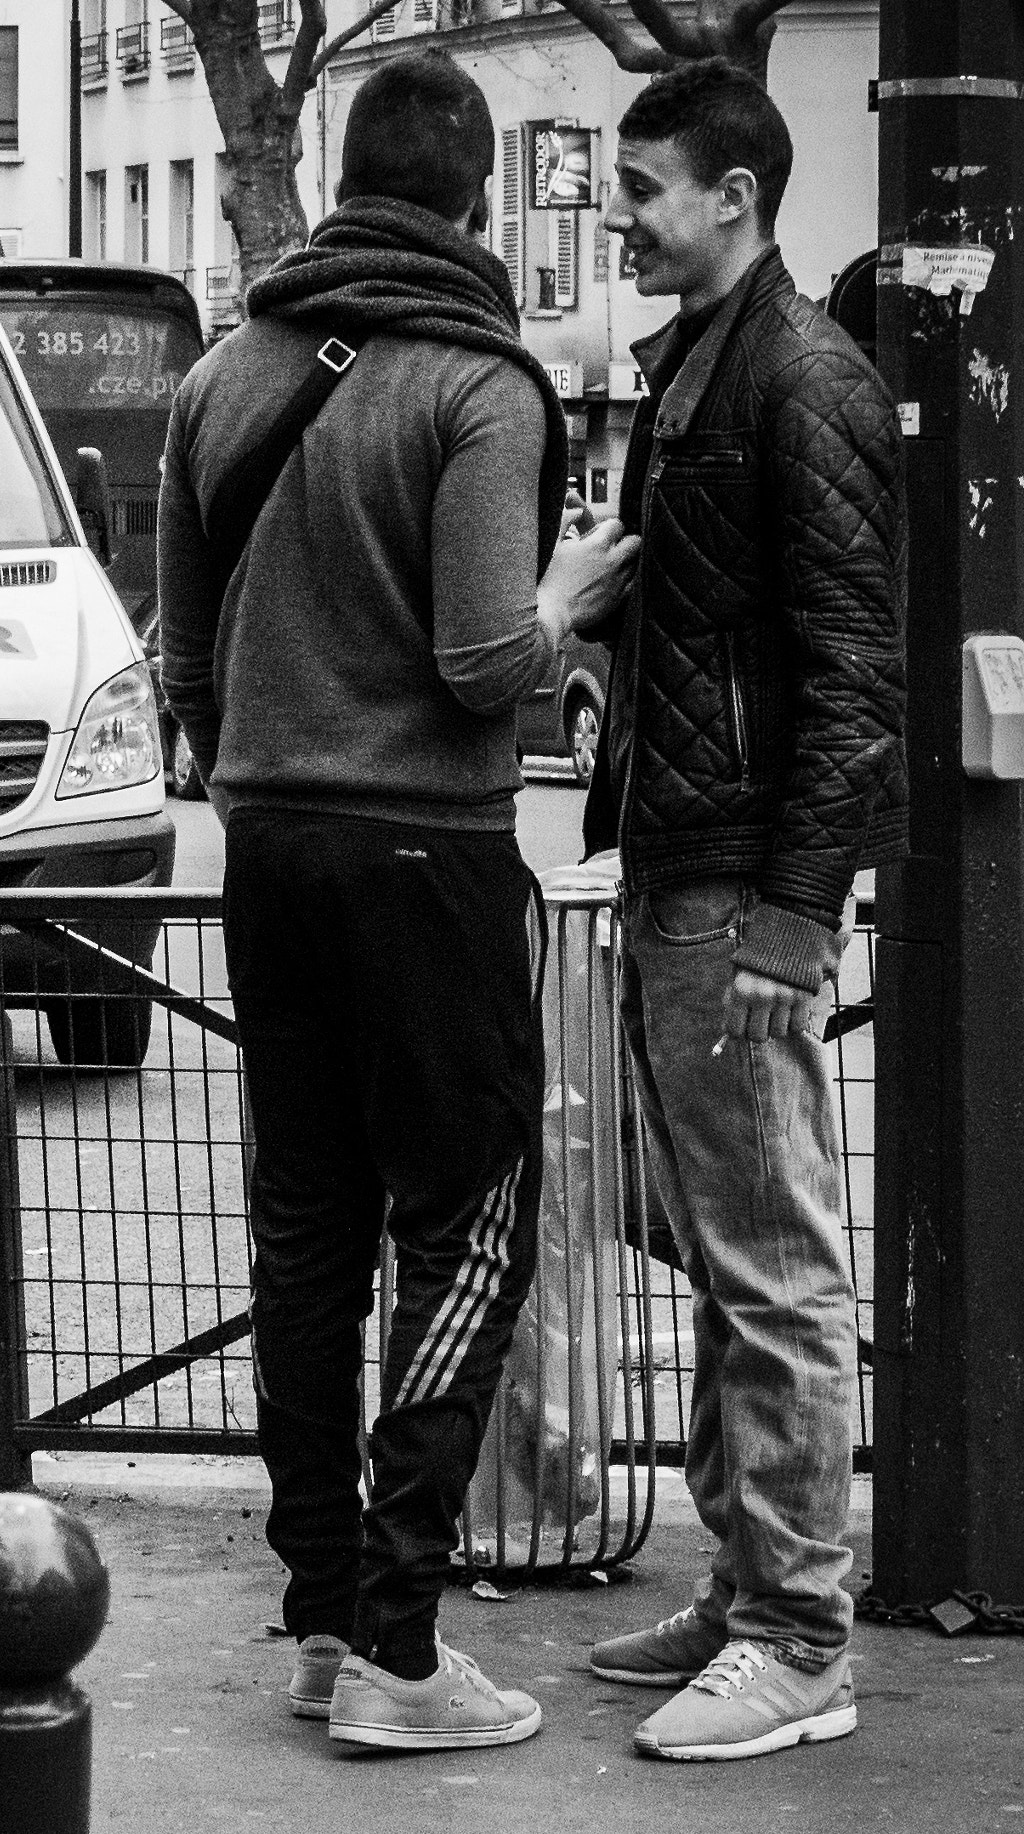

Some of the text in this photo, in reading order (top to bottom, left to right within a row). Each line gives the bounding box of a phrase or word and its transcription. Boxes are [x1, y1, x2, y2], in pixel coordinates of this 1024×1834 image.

[536, 131, 547, 207] RETRODOR
[922, 251, 958, 262] Remise
[37, 331, 84, 355] 385
[93, 332, 141, 356] 423
